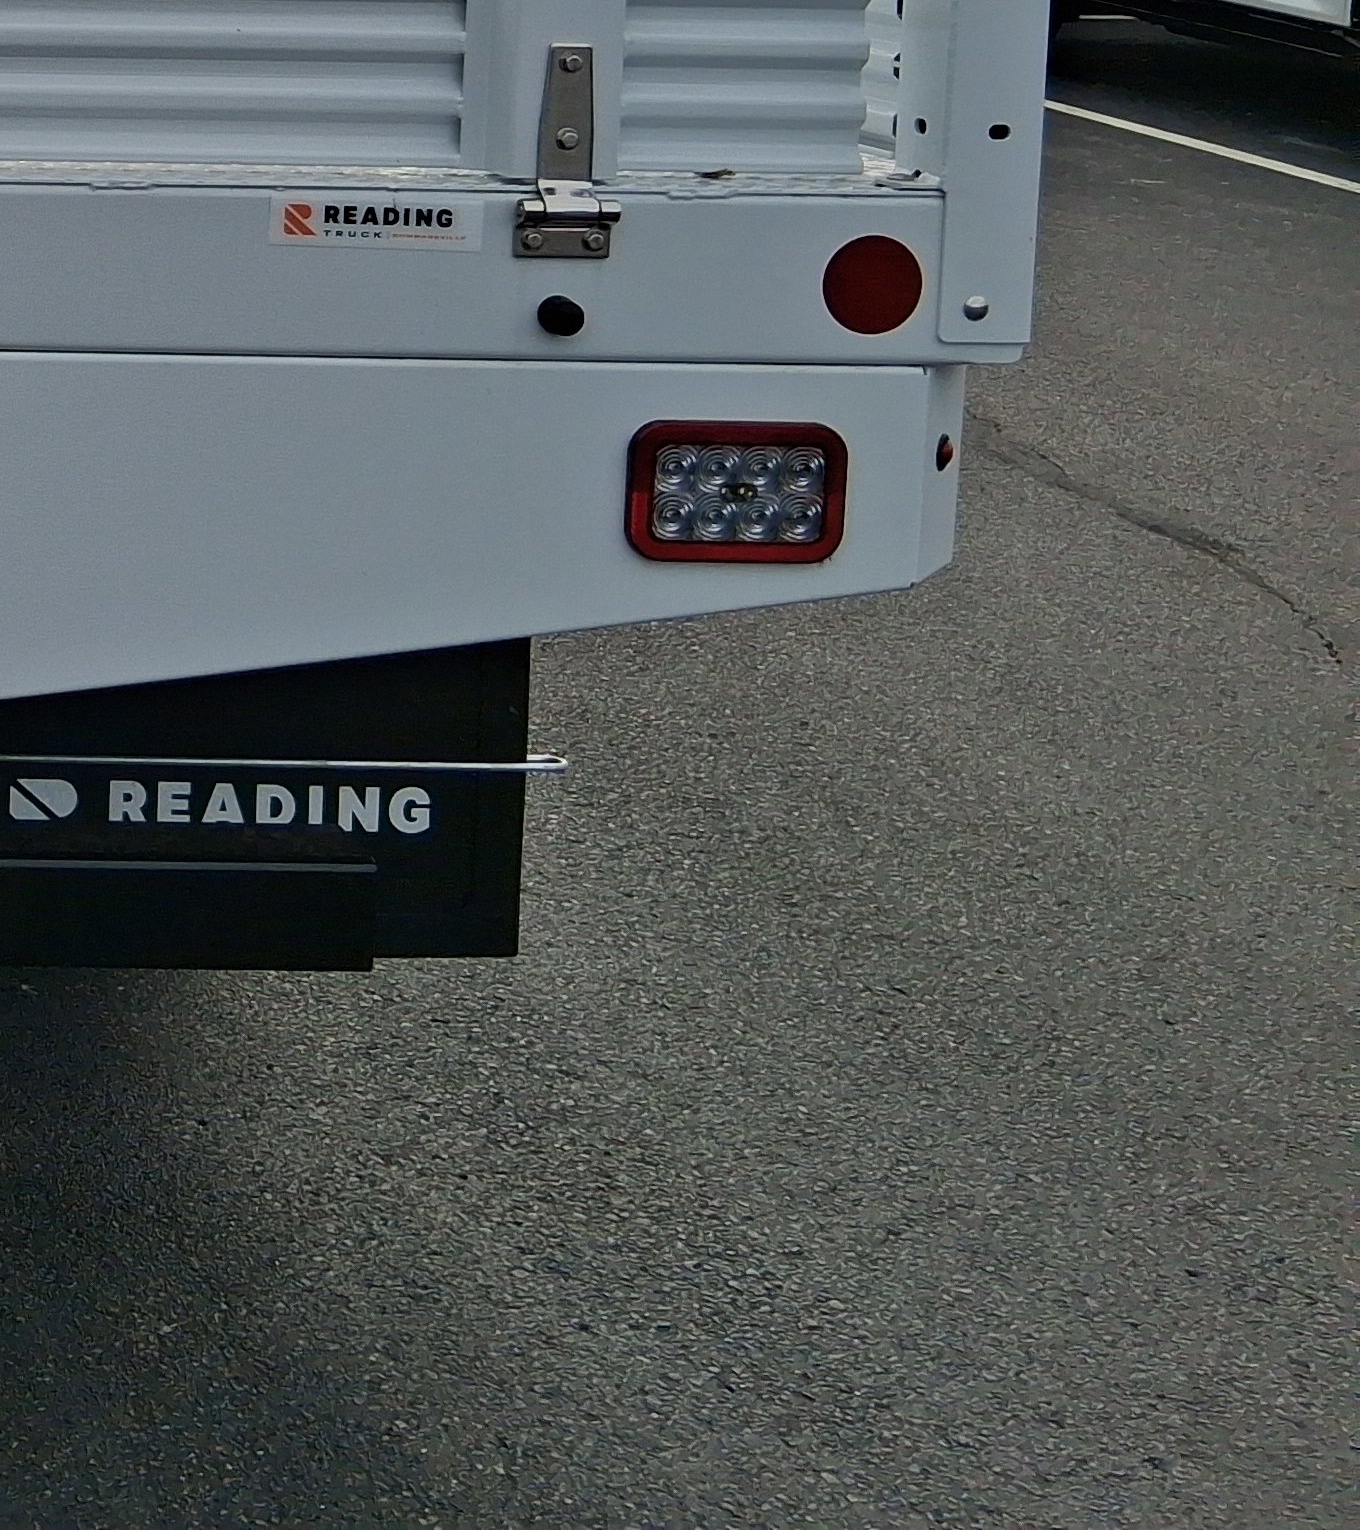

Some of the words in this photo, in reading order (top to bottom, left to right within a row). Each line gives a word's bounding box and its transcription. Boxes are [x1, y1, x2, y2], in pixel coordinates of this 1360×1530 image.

[324, 205, 453, 228] READING
[324, 230, 382, 238] TRUCK
[108, 779, 431, 834] READING
